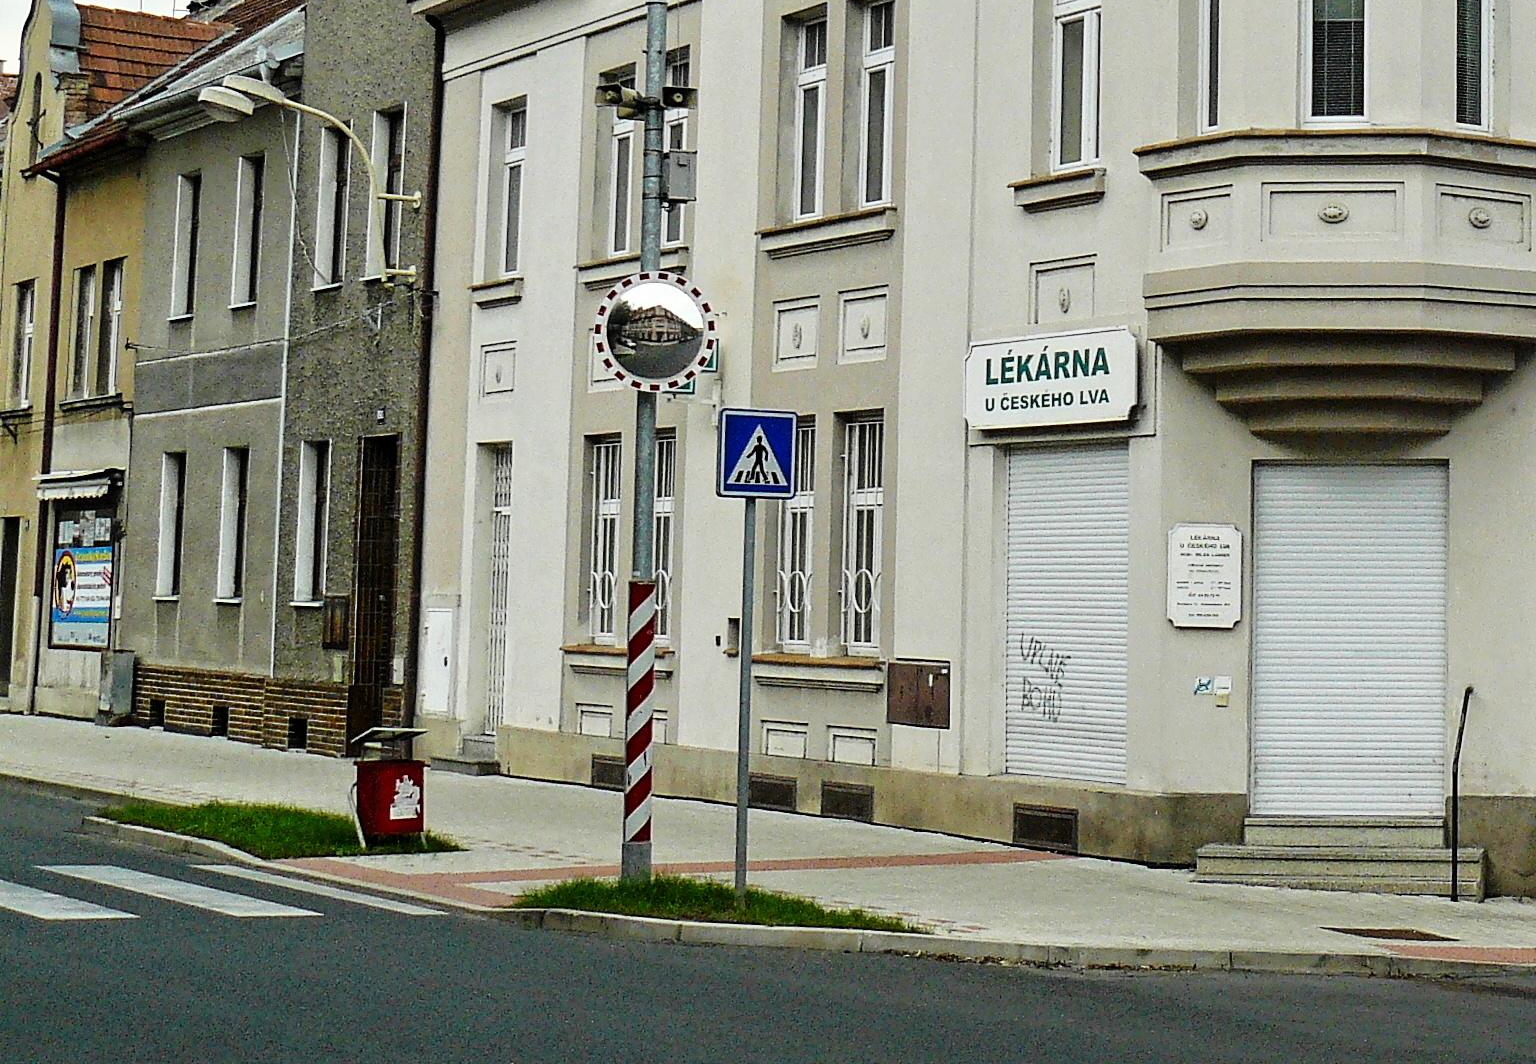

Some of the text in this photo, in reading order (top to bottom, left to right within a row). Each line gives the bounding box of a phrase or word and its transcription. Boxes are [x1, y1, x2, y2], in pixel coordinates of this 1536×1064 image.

[986, 346, 1110, 385] LÉKÁRNA
[985, 389, 1110, 411] U ČESKÉHO LVA
